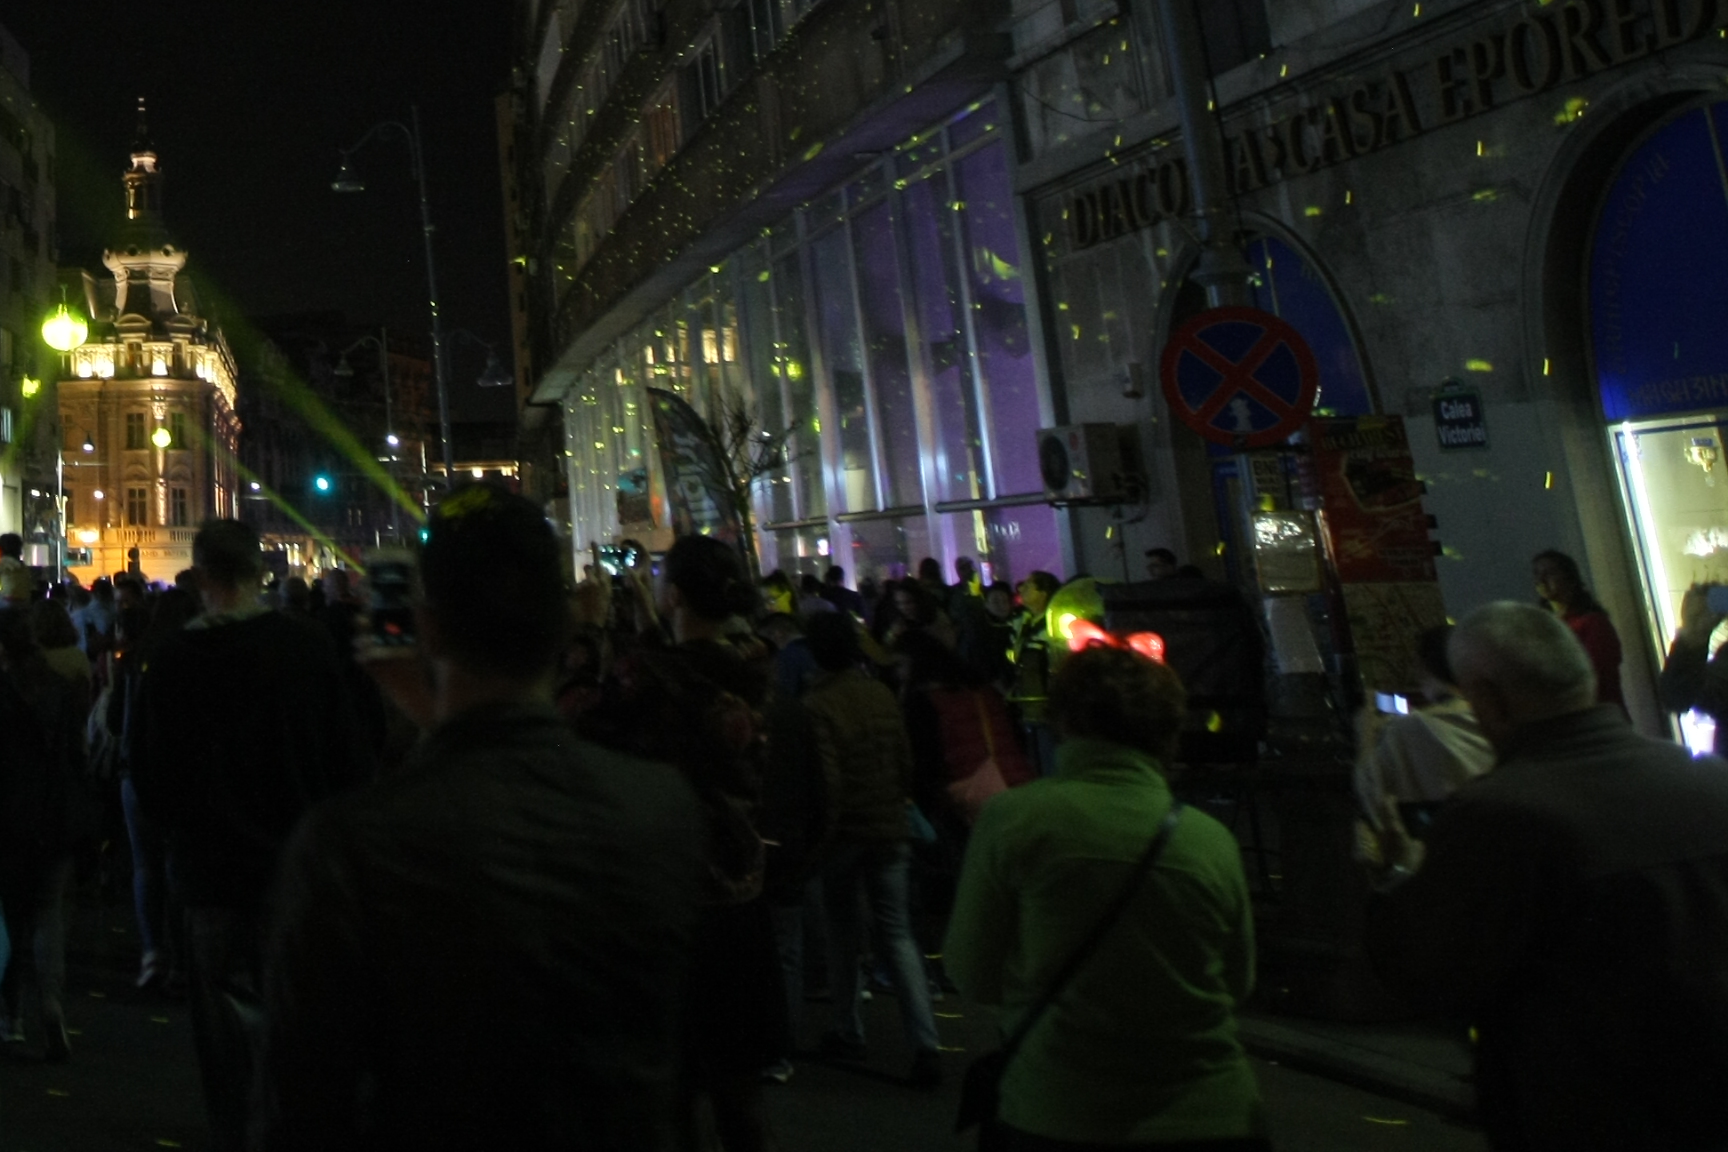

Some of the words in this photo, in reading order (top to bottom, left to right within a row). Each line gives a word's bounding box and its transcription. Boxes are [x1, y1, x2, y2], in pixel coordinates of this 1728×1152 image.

[1285, 69, 1422, 176] CASA
[1440, 400, 1473, 420] Calea
[1438, 422, 1485, 445] Victoriei
